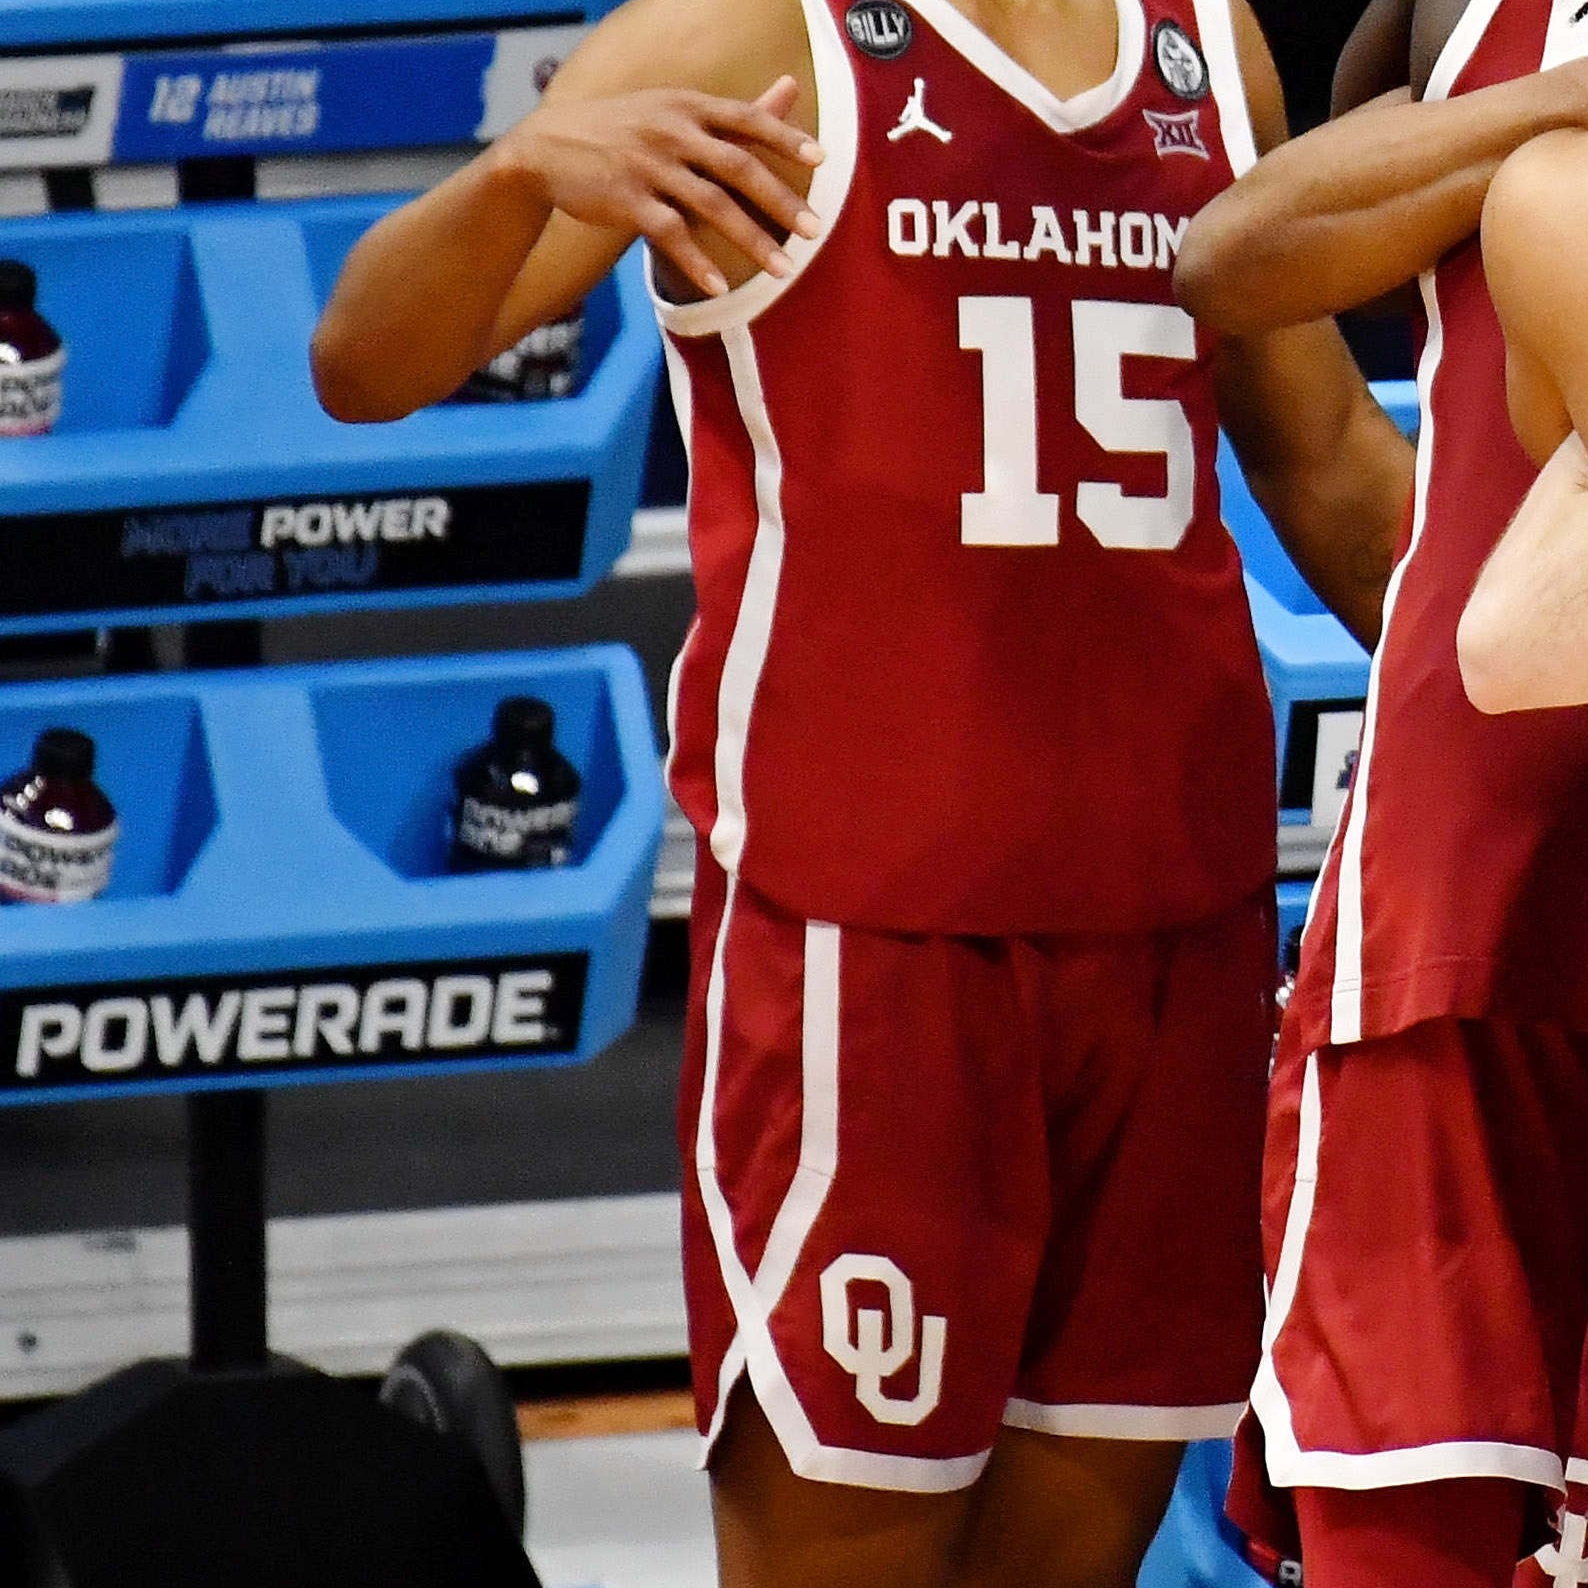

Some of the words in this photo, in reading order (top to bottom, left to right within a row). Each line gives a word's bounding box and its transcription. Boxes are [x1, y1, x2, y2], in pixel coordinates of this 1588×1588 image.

[958, 296, 1196, 551] 15
[261, 496, 450, 549] POWER
[16, 969, 554, 1078] POWERADE
[819, 1252, 948, 1427] OU
